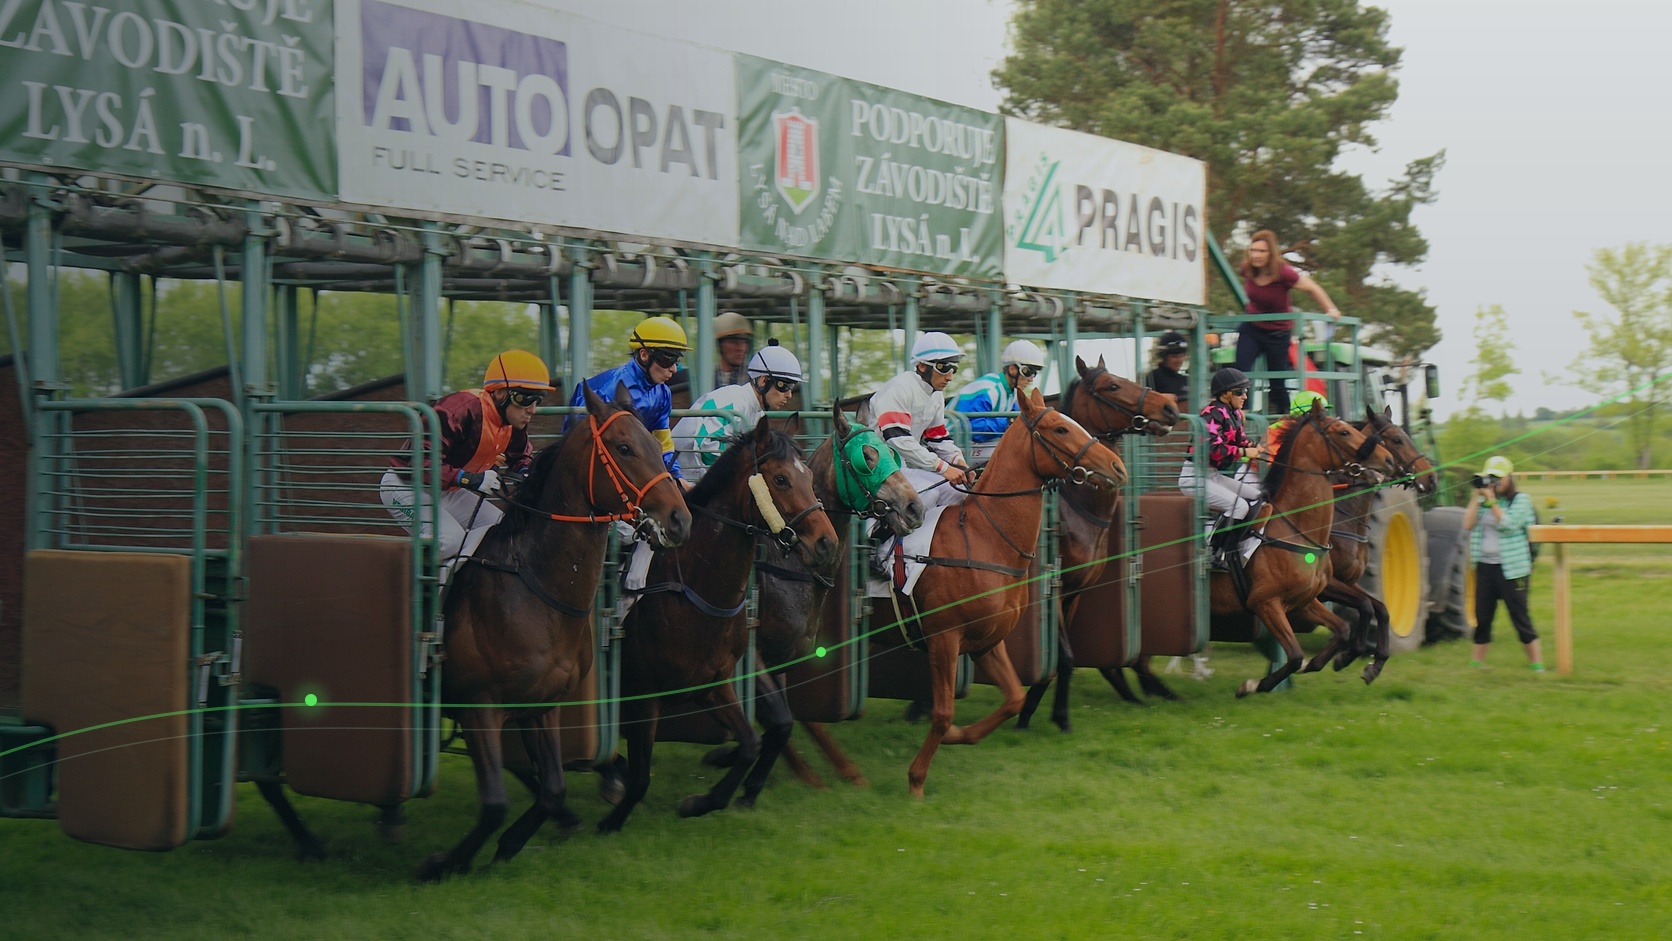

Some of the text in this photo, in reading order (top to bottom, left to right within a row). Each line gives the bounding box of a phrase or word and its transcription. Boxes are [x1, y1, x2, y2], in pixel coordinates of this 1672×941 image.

[21, 80, 276, 171] LYSÁ n. L.
[371, 46, 724, 180] AUTO OPAT
[850, 99, 997, 168] PODPORUJE
[372, 146, 567, 191] FULL SERVICE
[855, 152, 995, 214] ZÁVODIŠTĚ
[871, 213, 934, 256] LYSÁ
[1074, 184, 1198, 263] PRAGIS
